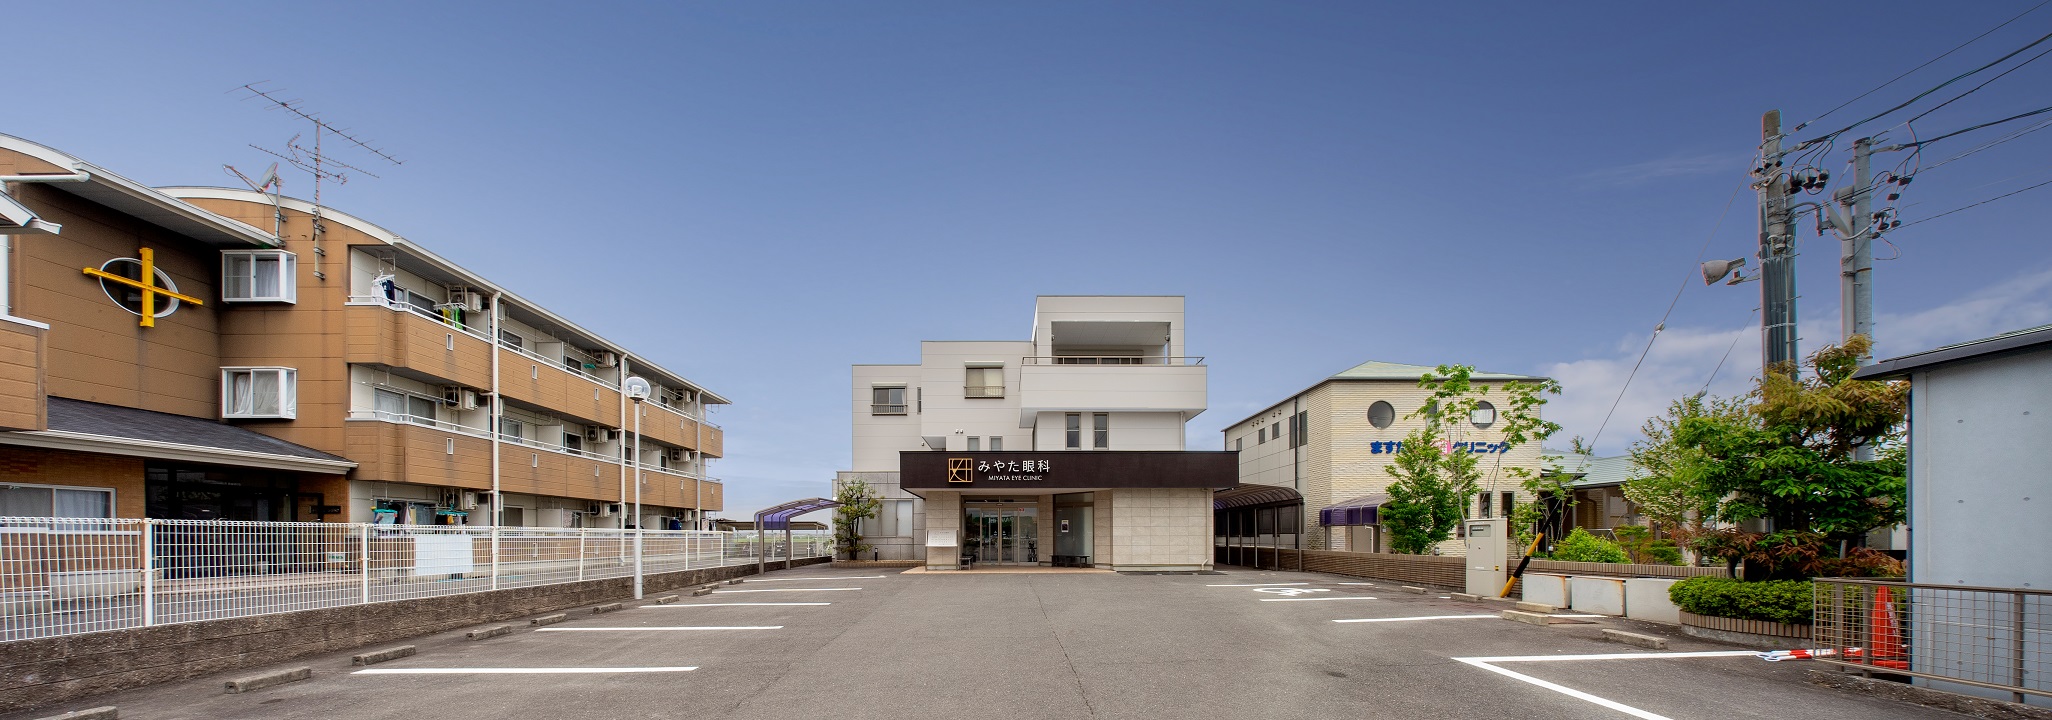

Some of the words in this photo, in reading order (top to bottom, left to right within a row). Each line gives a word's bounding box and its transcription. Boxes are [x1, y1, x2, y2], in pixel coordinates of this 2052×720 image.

[978, 460, 1050, 473] みやた眼科
